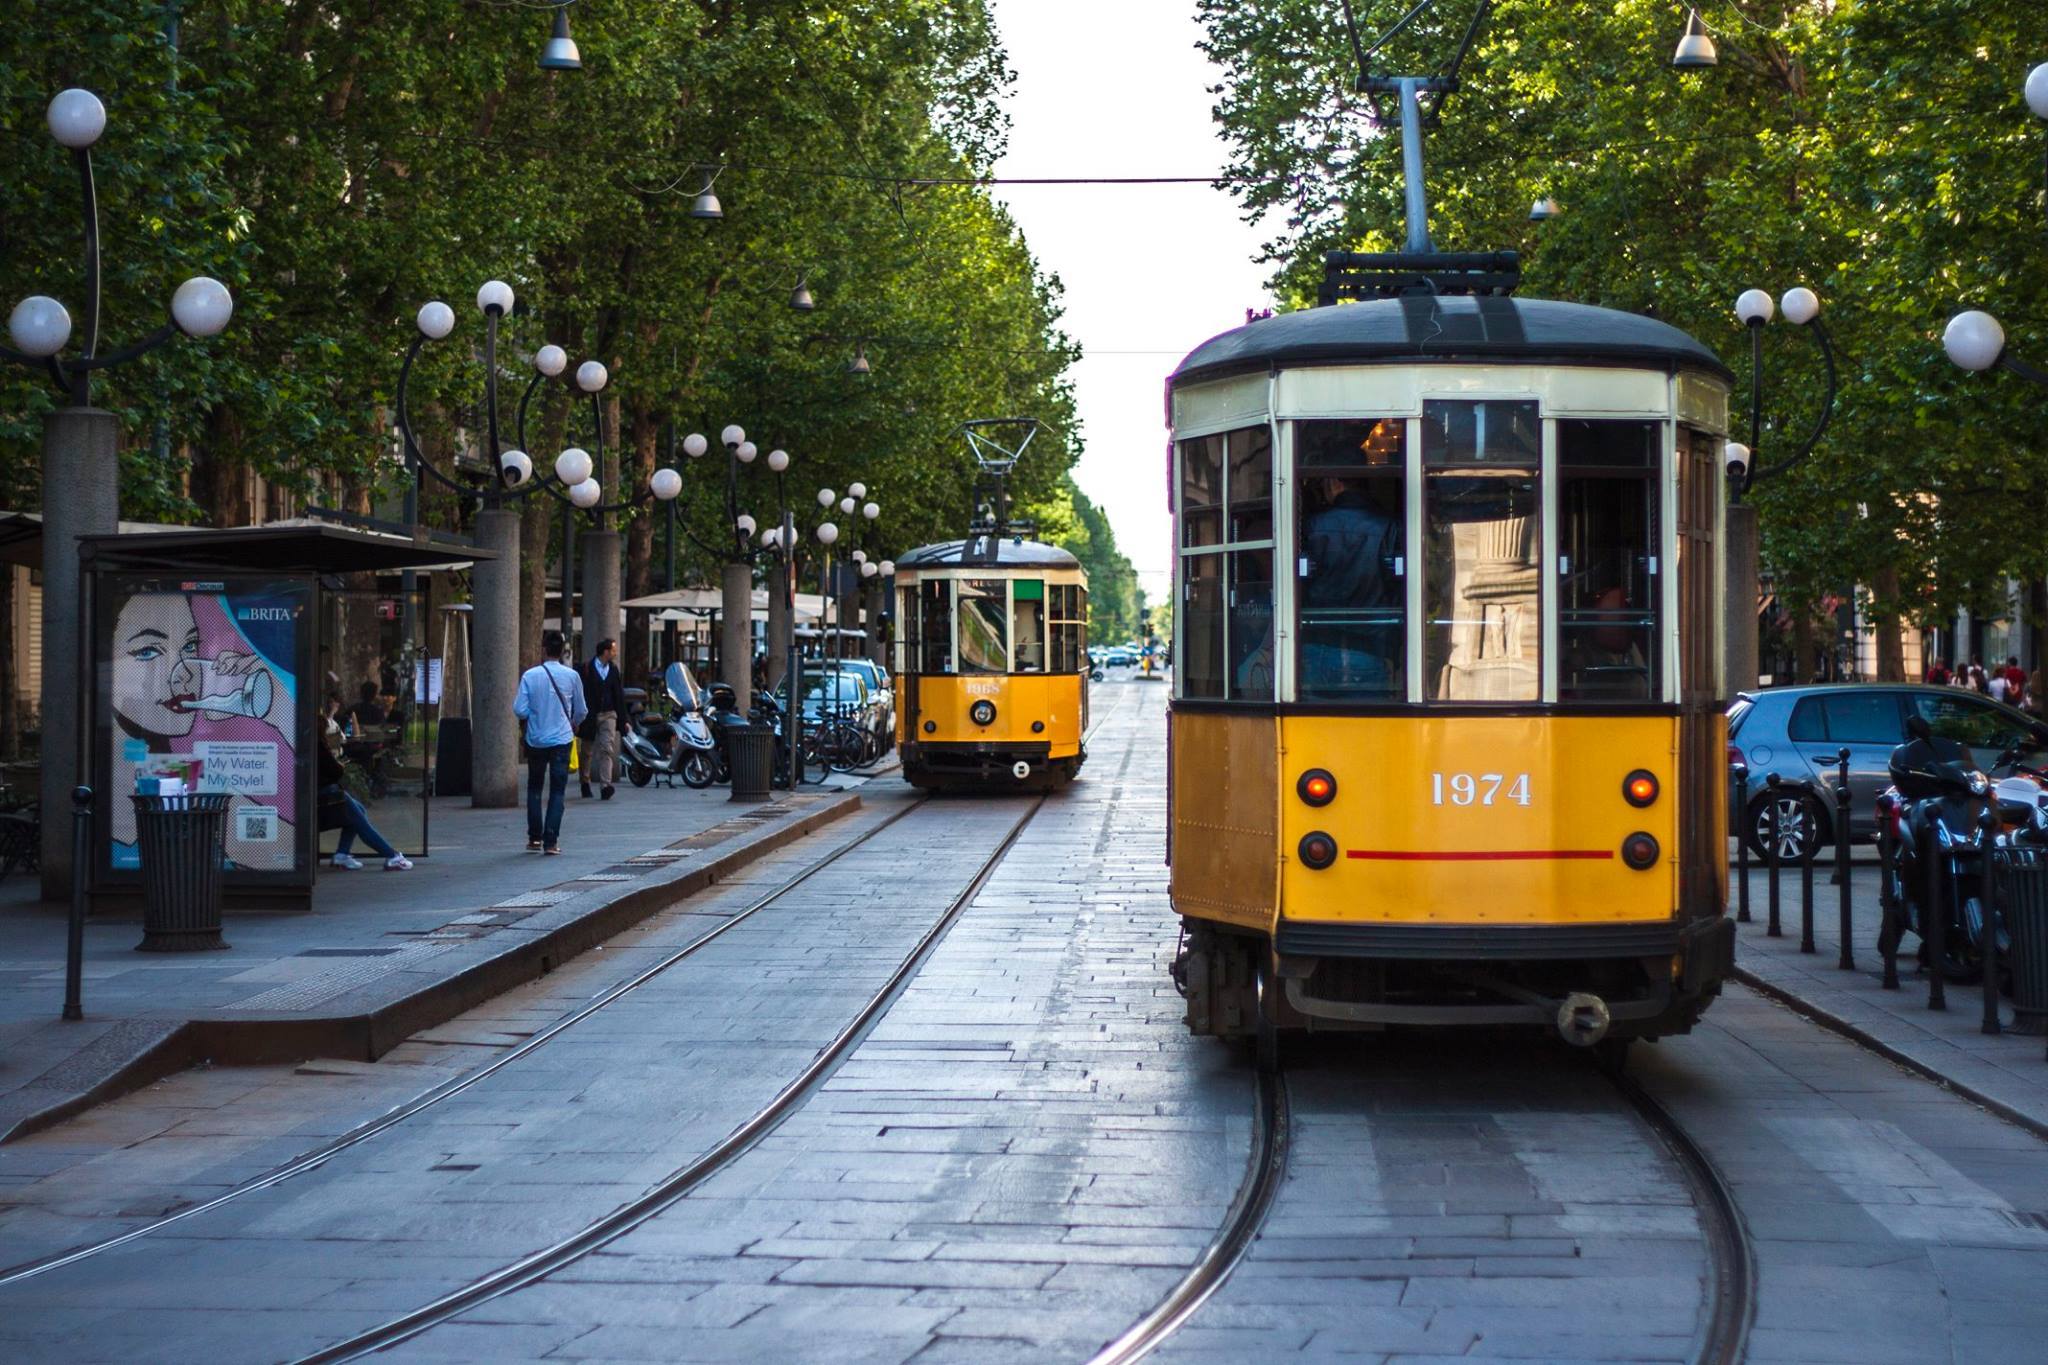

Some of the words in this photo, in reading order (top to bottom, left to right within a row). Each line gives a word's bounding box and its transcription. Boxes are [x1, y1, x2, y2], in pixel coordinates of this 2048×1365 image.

[250, 608, 290, 621] BRITA
[208, 757, 227, 771] My
[208, 774, 227, 788] My
[231, 774, 264, 788] Style!
[1432, 773, 1531, 806] 1974
